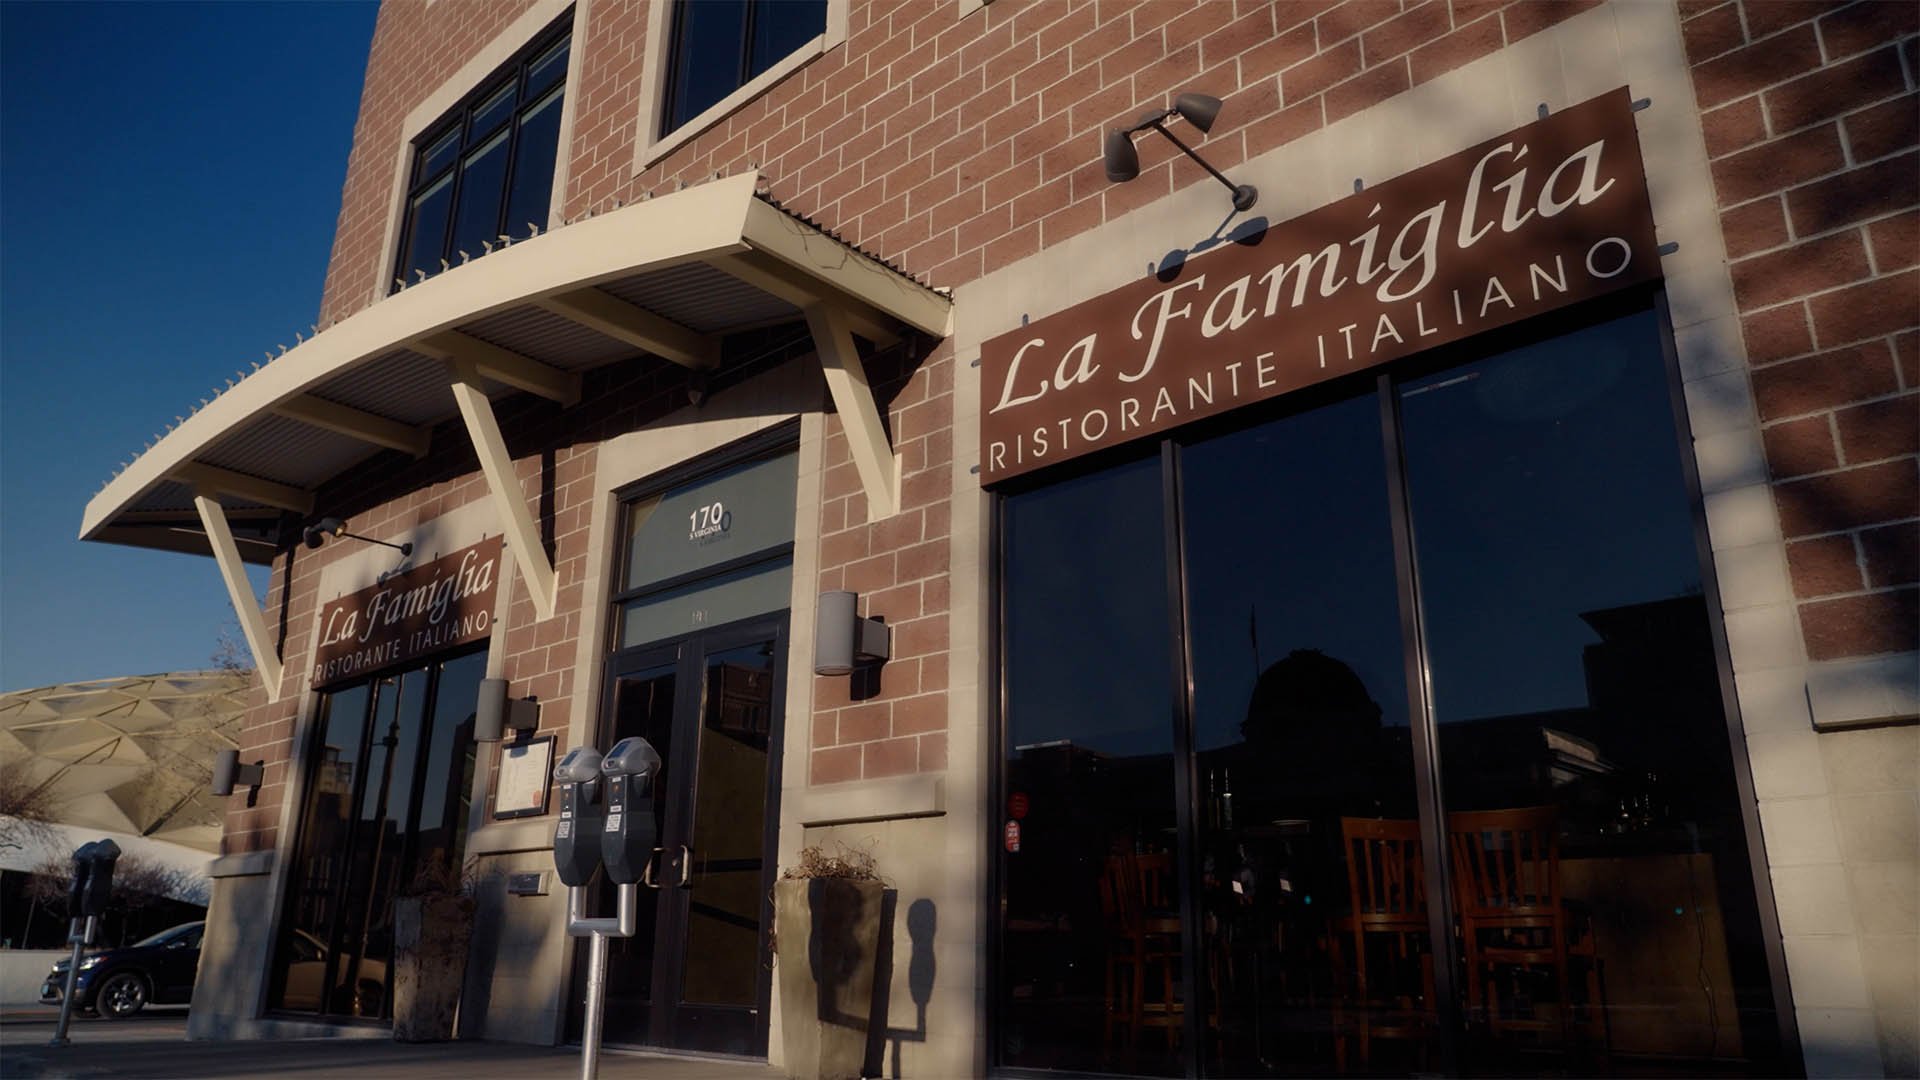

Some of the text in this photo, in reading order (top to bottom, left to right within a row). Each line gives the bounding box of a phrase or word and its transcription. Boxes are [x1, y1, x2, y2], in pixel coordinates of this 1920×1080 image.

[989, 139, 1615, 414] La Famiglia
[989, 237, 1631, 472] RISTORANTE ITALIANO
[690, 502, 722, 532] 170
[314, 610, 488, 682] RISTORANTE ITALIANO
[320, 550, 495, 647] La Famiglia
